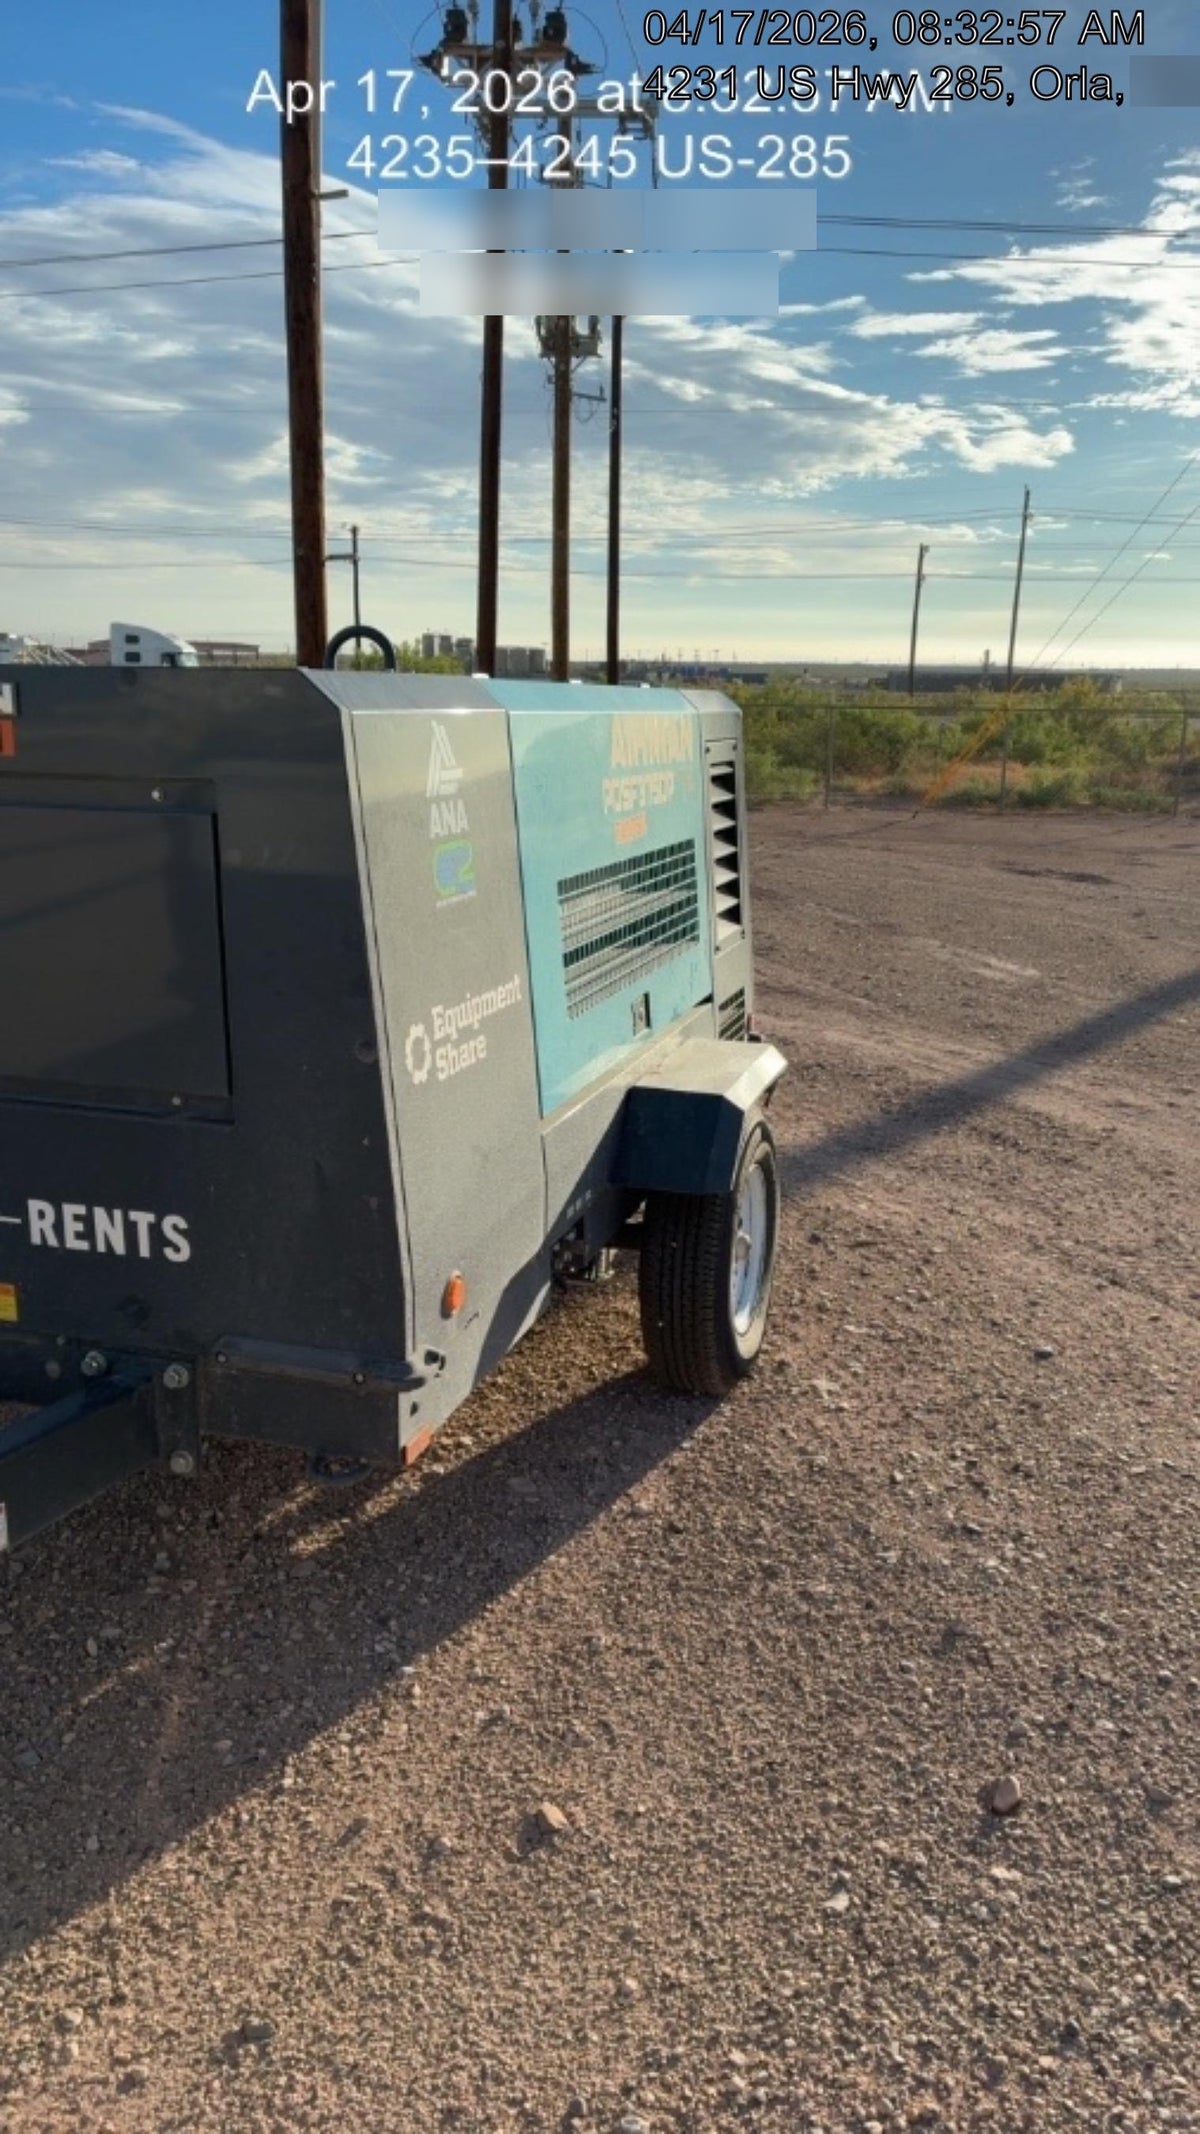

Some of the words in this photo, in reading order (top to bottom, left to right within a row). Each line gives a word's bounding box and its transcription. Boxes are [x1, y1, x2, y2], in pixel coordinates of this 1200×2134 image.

[430, 799, 470, 838] ANA
[431, 973, 522, 1041] Equipment
[435, 1034, 487, 1080] Share
[27, 1198, 192, 1263] RENTS
